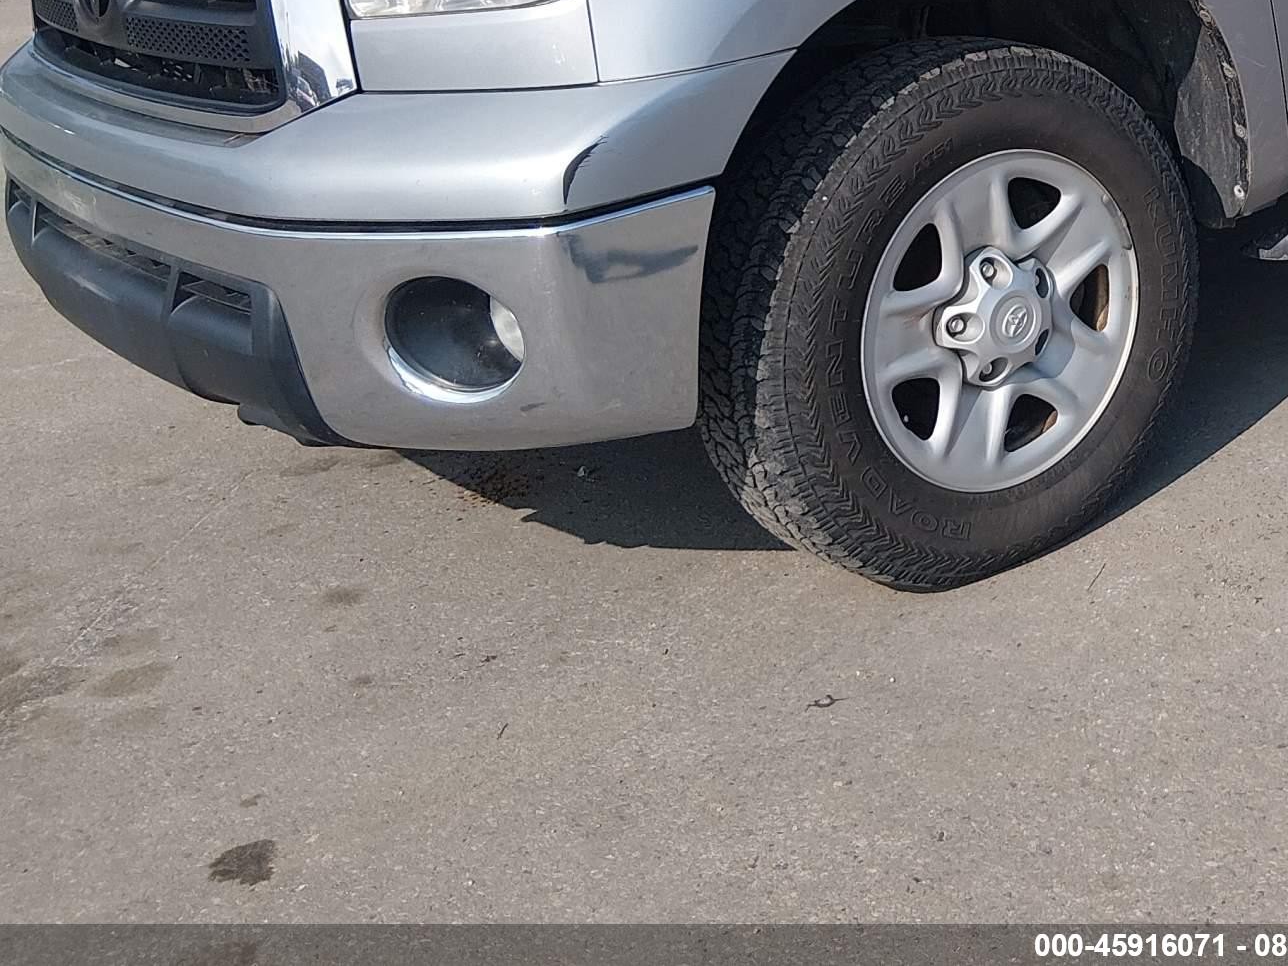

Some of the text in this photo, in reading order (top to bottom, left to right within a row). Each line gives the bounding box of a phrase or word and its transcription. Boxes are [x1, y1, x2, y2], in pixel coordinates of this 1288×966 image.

[825, 172, 906, 466] VENTURE
[1143, 185, 1180, 383] KUMHO
[861, 465, 973, 542] ROAD
